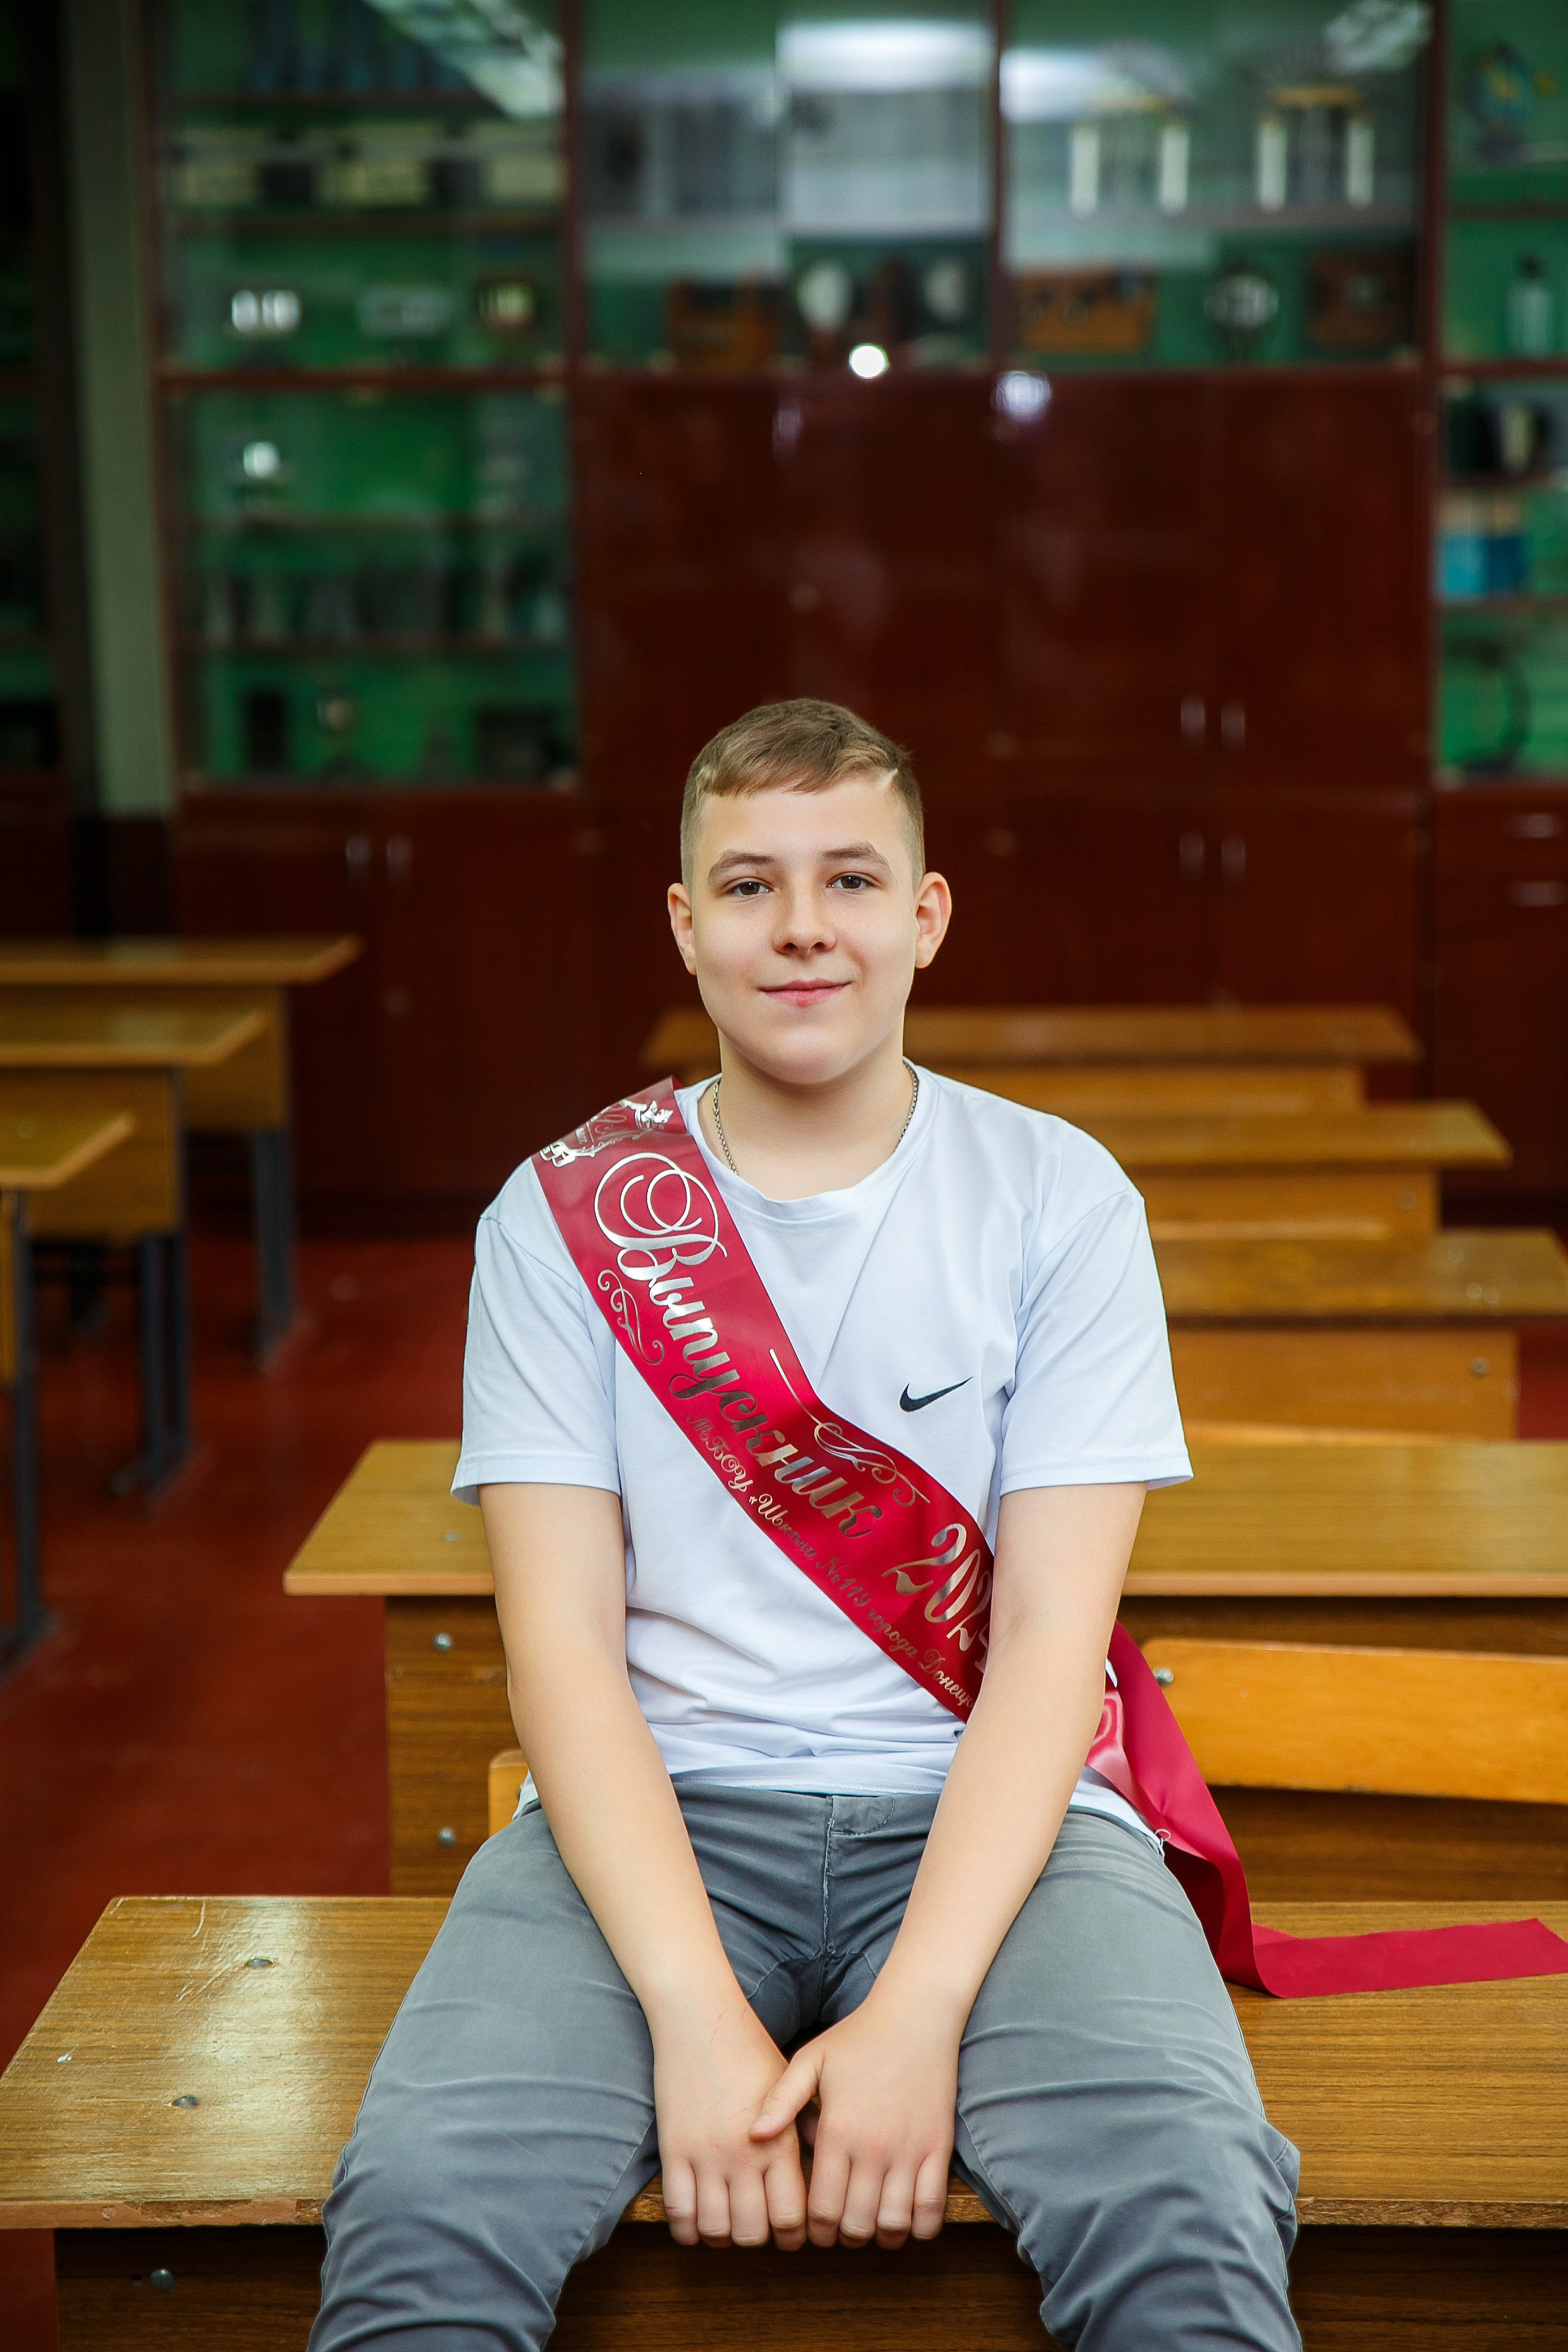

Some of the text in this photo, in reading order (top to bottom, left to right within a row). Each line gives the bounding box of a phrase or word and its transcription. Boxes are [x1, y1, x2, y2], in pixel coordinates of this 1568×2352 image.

[594, 1152, 882, 1538] Выпускник
[687, 1415, 753, 1492] МБОУ
[749, 1493, 817, 1560] «Школа
[816, 1556, 871, 1607] №119
[867, 1608, 918, 1659] города
